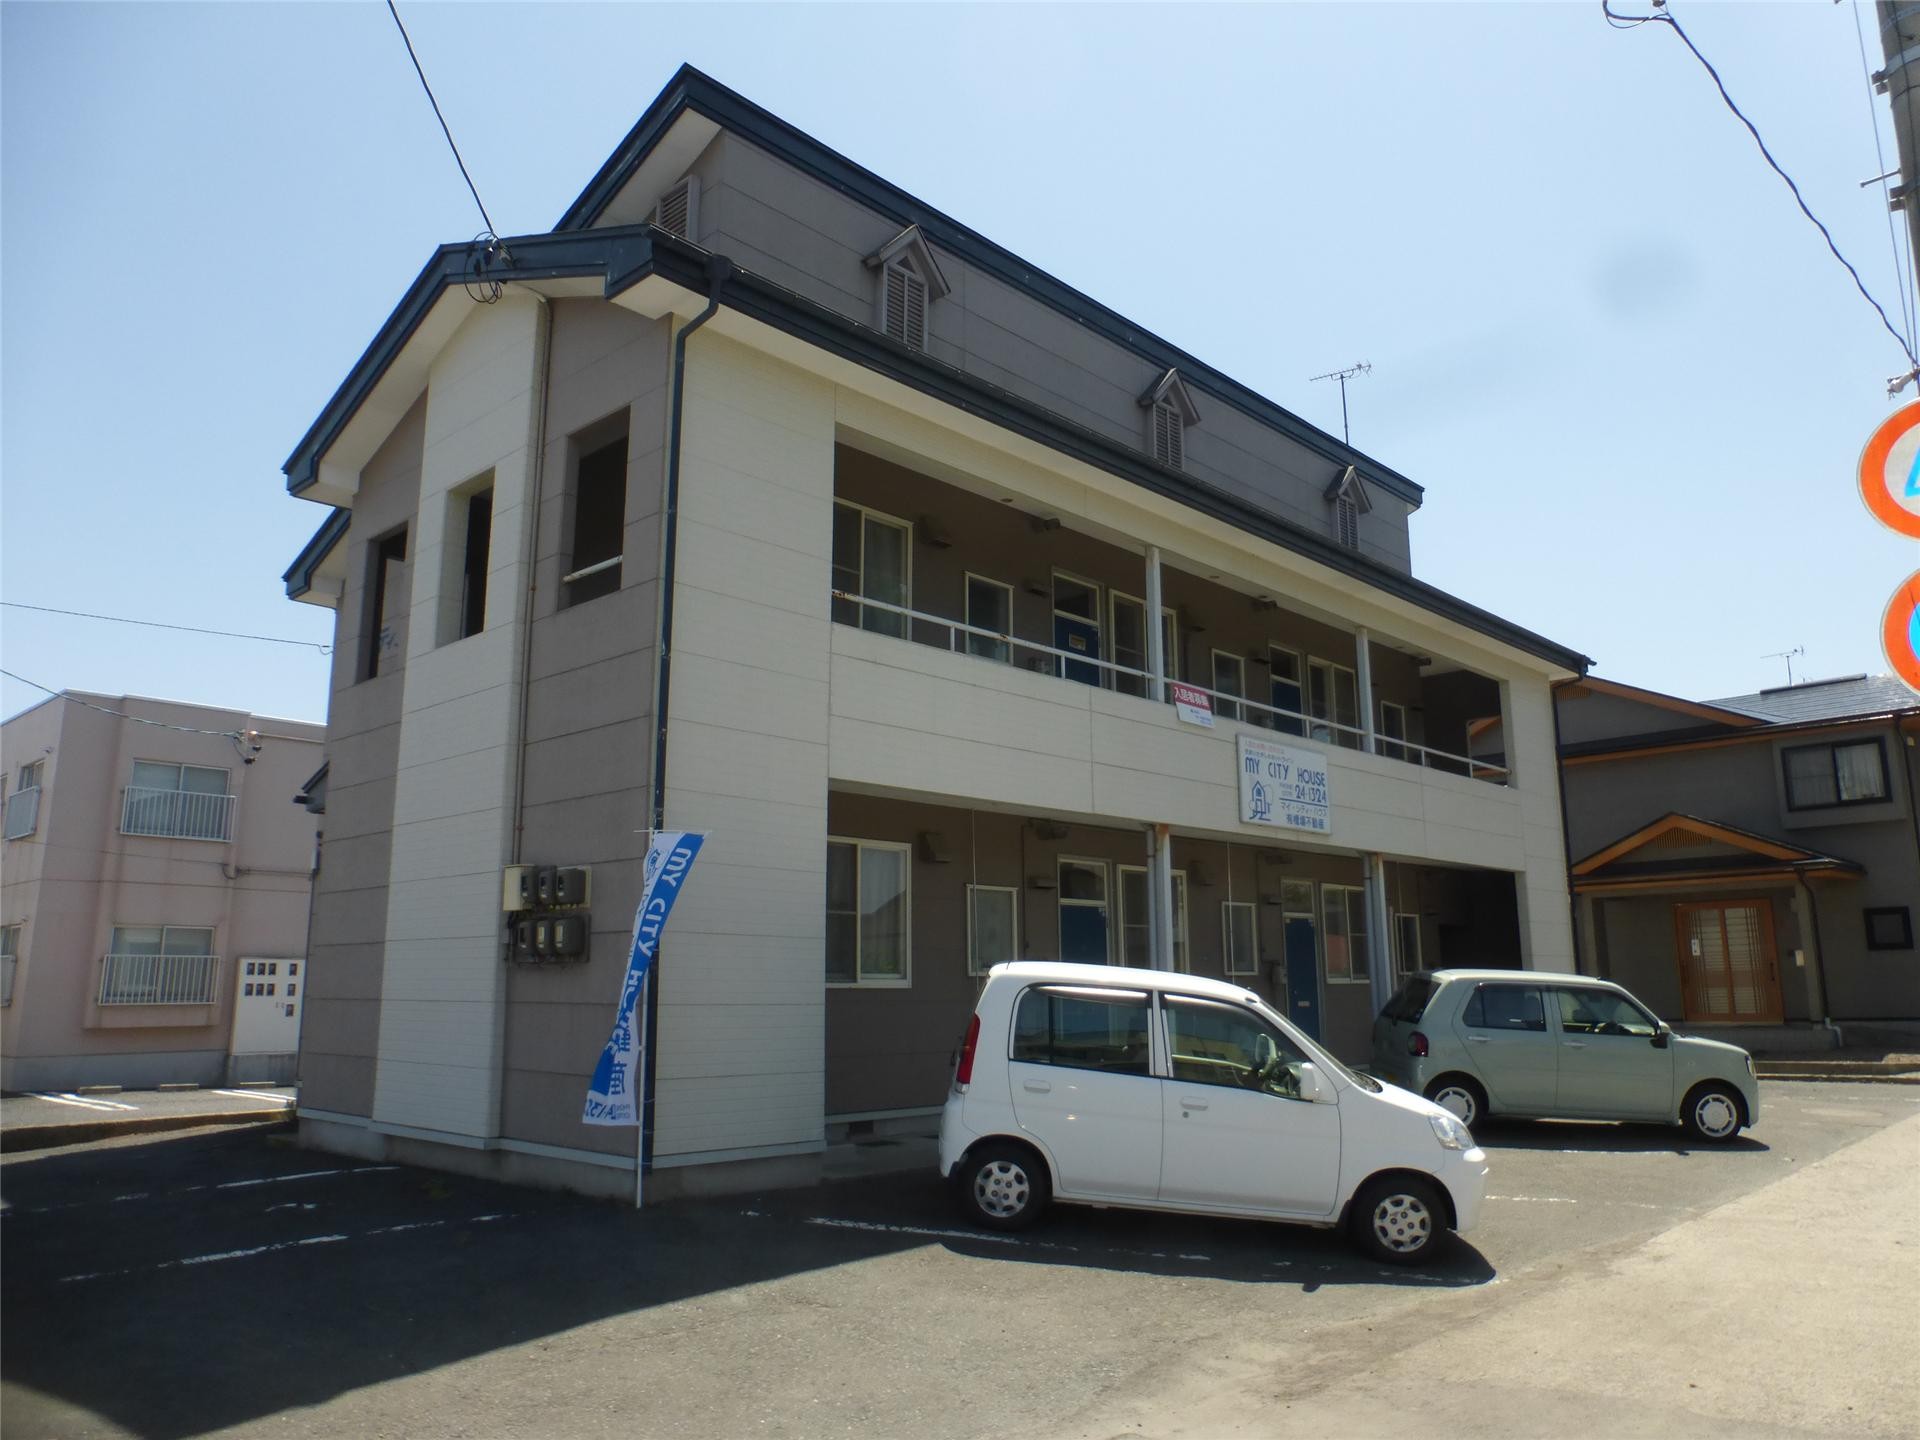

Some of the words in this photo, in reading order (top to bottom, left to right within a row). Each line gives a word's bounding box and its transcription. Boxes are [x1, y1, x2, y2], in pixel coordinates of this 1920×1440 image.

[1245, 756, 1260, 775] MY
[1268, 762, 1289, 780] CITY
[1297, 768, 1326, 788] HOUSE
[661, 847, 692, 888] MY
[638, 898, 666, 957] CITY
